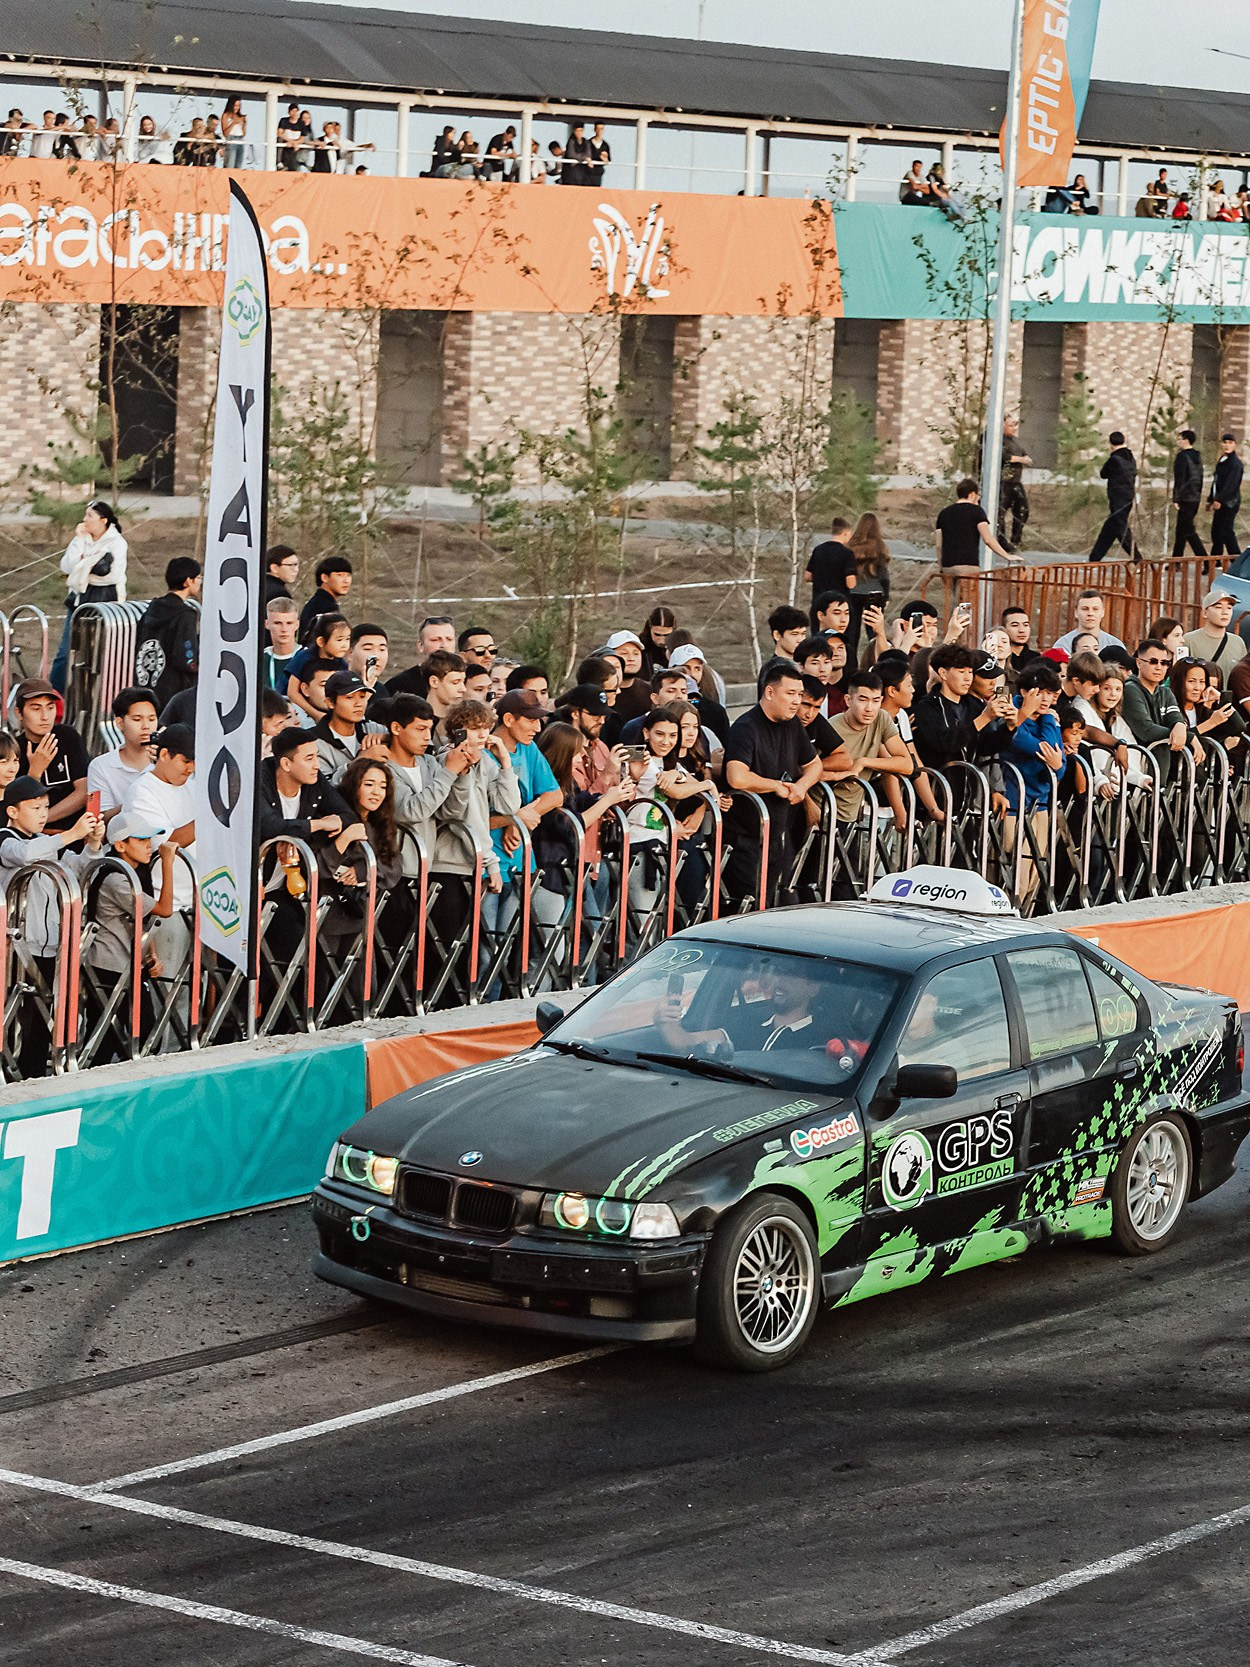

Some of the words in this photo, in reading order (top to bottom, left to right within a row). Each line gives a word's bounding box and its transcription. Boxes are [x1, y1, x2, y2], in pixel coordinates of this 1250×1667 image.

[912, 884, 967, 901] region
[810, 1114, 858, 1146] Castrol
[937, 1110, 1014, 1172] GPS
[0, 1108, 82, 1240] T
[939, 1162, 1012, 1194] КОНТРОЛЬ
